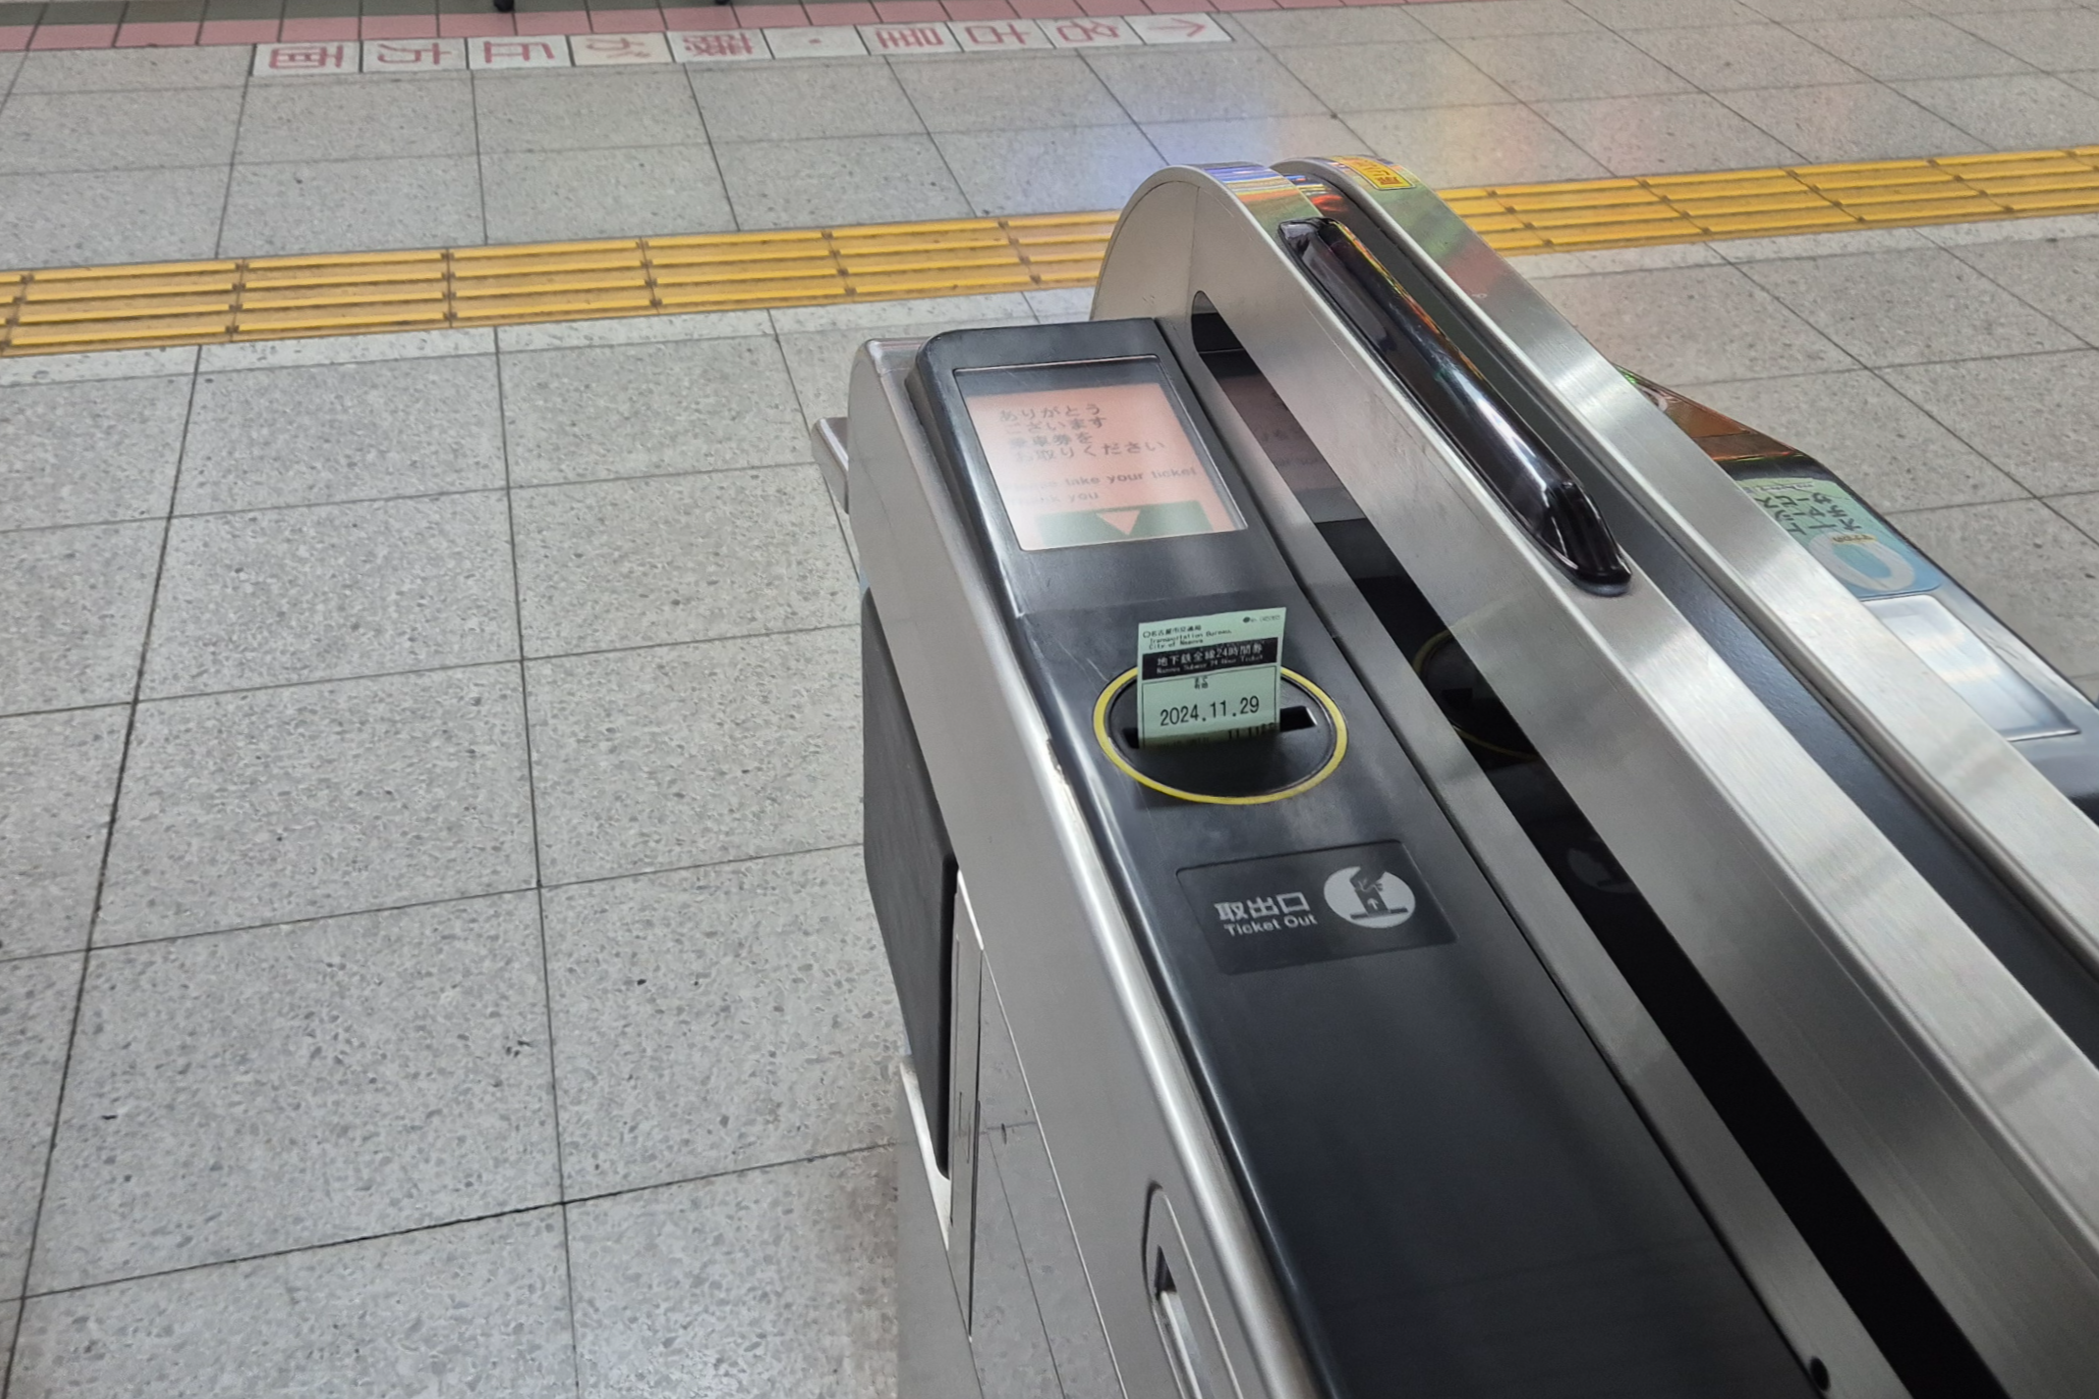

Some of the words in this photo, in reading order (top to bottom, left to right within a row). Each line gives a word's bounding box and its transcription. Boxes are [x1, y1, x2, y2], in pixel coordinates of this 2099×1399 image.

[1000, 403, 1101, 423] ありがとう
[1015, 440, 1166, 464] お取りください
[1065, 476, 1100, 487] take
[1106, 471, 1144, 486] your
[1151, 467, 1197, 480] ticket
[1068, 491, 1099, 504] you
[1157, 642, 1263, 667] 地下鉄全線24時間券
[1160, 695, 1260, 727] 2024.11.29
[1214, 892, 1311, 921] 取出口
[1223, 918, 1281, 936] Ticket
[1284, 913, 1318, 928] Out
